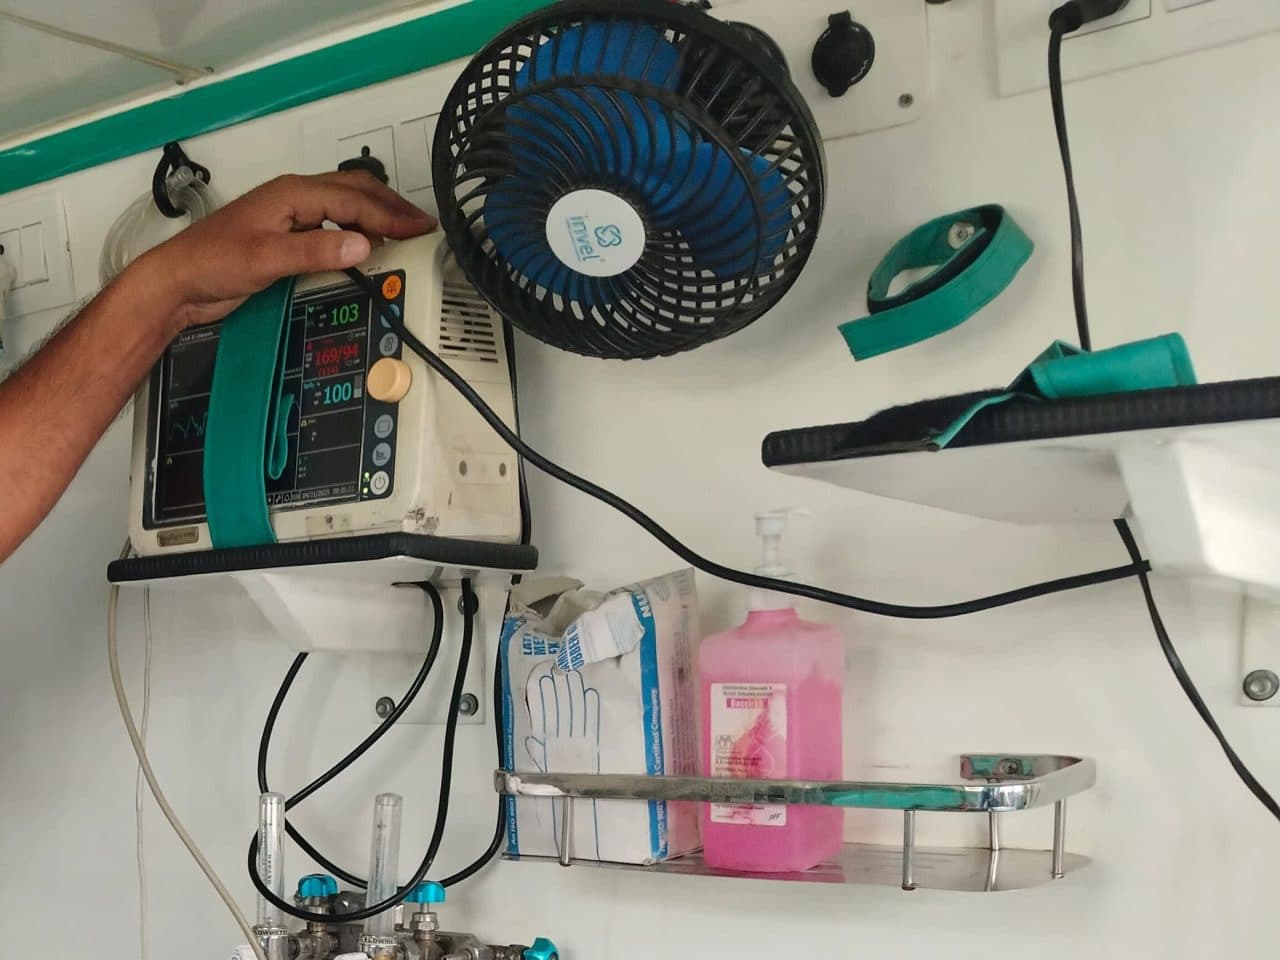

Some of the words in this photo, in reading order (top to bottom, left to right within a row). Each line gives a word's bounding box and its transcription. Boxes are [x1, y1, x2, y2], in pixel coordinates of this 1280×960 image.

[330, 303, 359, 326] 103
[315, 343, 359, 368] 169/94
[323, 382, 352, 405] 100
